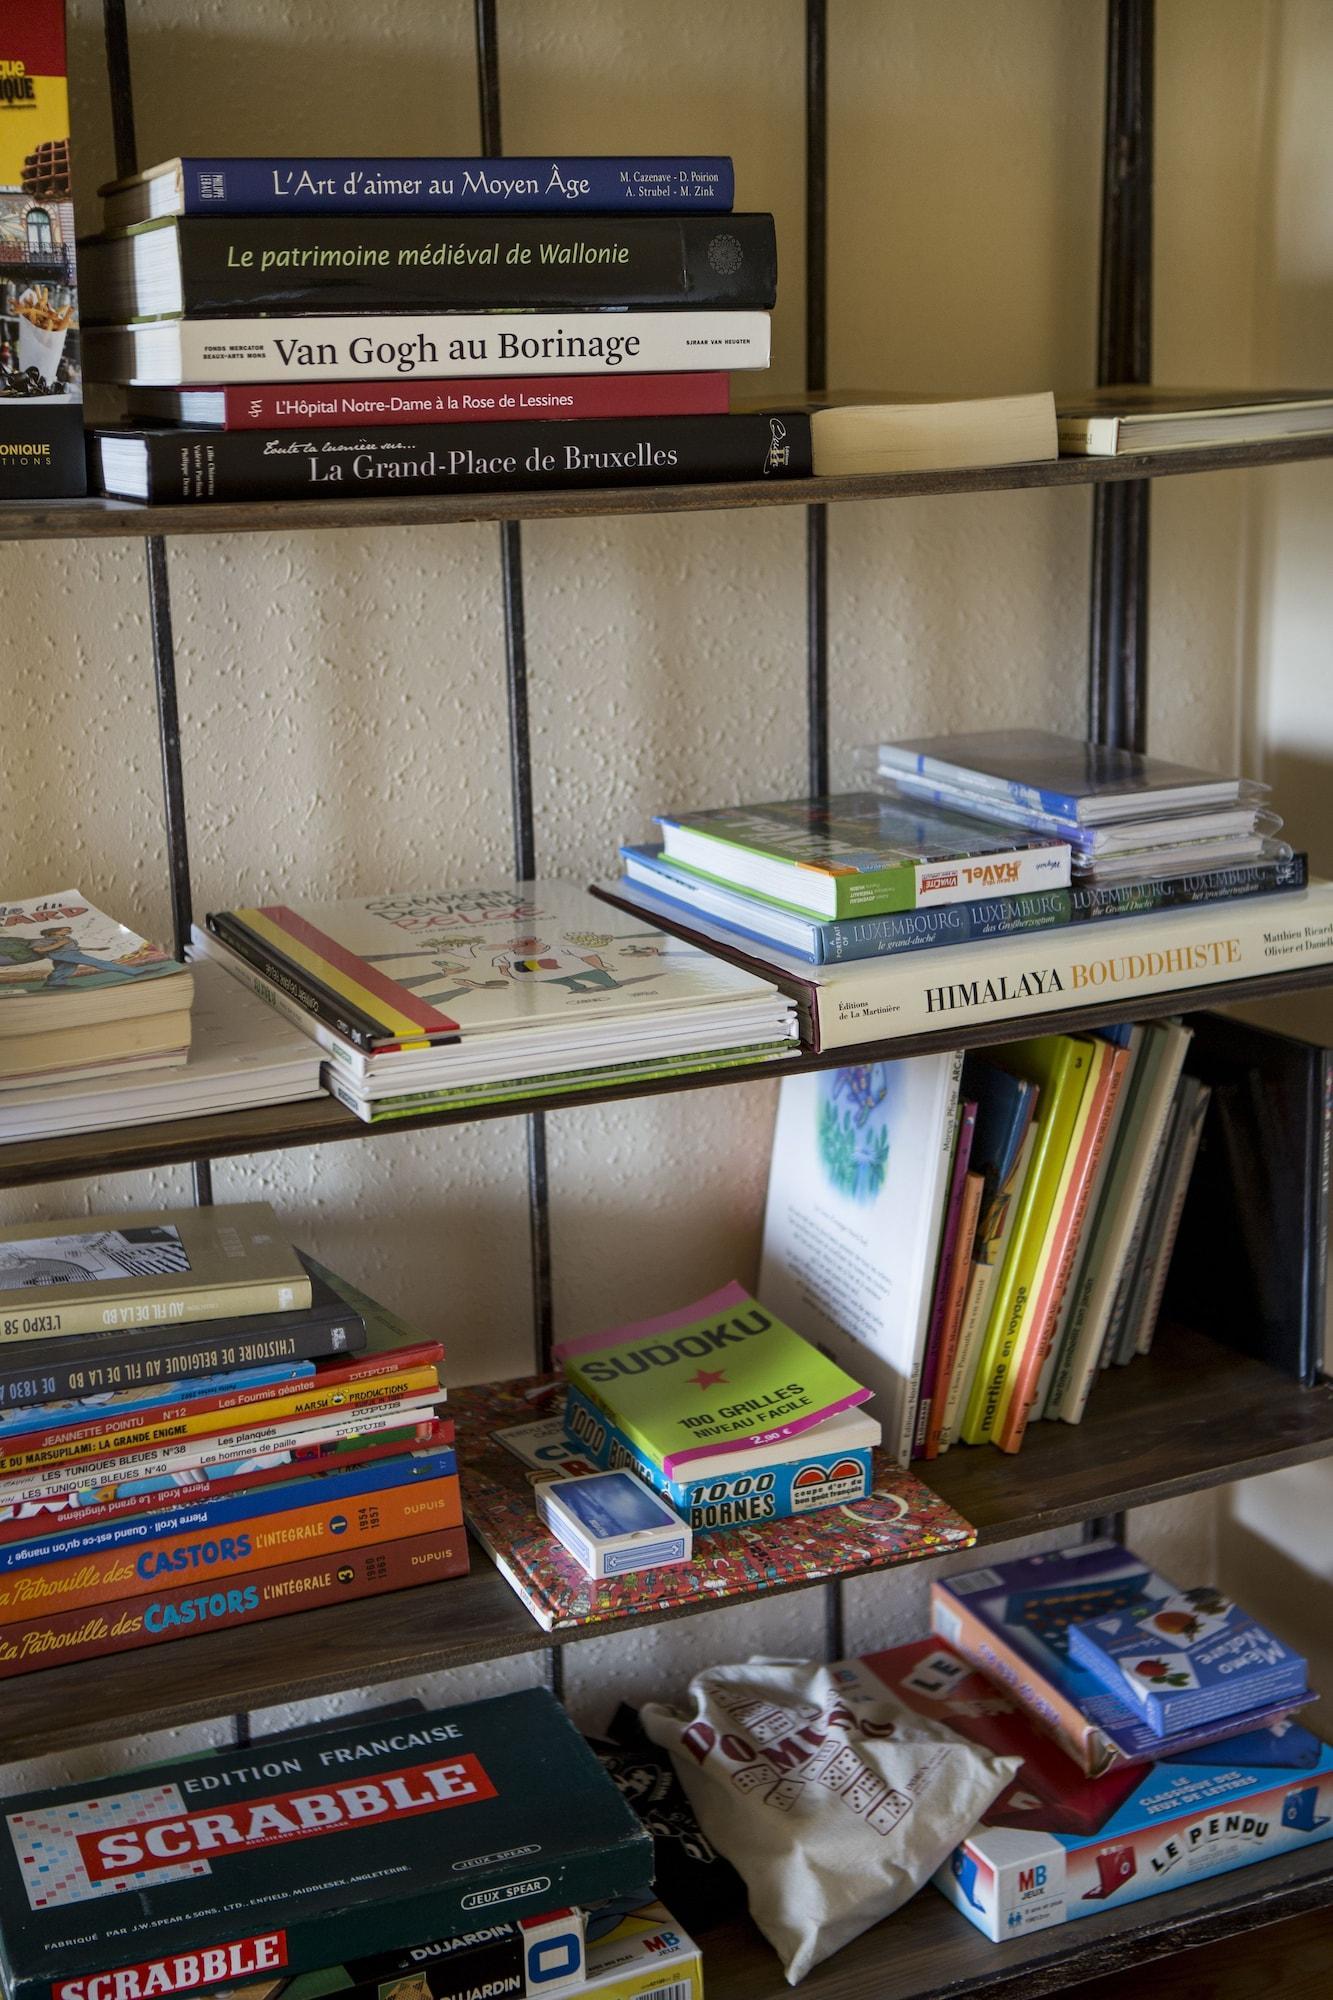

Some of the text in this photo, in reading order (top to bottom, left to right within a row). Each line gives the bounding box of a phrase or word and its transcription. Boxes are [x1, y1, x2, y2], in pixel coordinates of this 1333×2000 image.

[272, 164, 590, 199] L'Art d'aimer au Moyen Âge
[633, 171, 719, 183] Cazenave Poirion
[639, 186, 714, 197] Strubel Zink
[227, 243, 629, 272] Le patrimoine médiéval de Wallonie
[273, 329, 641, 372] Van Gogh au Borinage
[276, 400, 338, 417] L'Hôpital
[342, 397, 432, 413] Notre-Dame
[435, 396, 444, 409] à
[447, 396, 459, 409] la
[462, 395, 495, 409] Rose
[498, 394, 515, 407] de
[519, 394, 574, 407] Lessines
[308, 442, 678, 482] La Grand-Place de Bruxelles
[391, 906, 545, 931] BELGE
[887, 933, 936, 951] grand-duché
[1264, 944, 1293, 957] Olivier
[924, 939, 1242, 1013] HIMALAYA BOUDDHISTE
[862, 1004, 900, 1017] Martinière
[4, 1315, 61, 1335] L'EXPO 58
[103, 1302, 184, 1325] AU FIL DE LA BD
[580, 1310, 773, 1383] SUDOKU
[981, 1286, 1027, 1431] martine voyage
[9, 1339, 295, 1399] L'HISTOIRE DE BELGIQUE AU FIL DE LA BD DE 1830
[42, 1425, 103, 1447] JEANNETTE
[105, 1417, 144, 1433] POINTU
[162, 1408, 187, 1420] N°12
[218, 1398, 236, 1409] Les
[238, 1390, 276, 1405] Fourmis
[278, 1381, 315, 1398] géantes
[350, 1364, 399, 1381] DUPUIS
[677, 1383, 805, 1429] 100 GRILLES
[693, 1396, 814, 1439] NIVEAU FACILE
[9, 1383, 409, 1468] DU MARSUPILAMI: LA GRANDE ENIGME MARSU PRODUCTIONS
[42, 1471, 61, 1482] LES
[65, 1460, 116, 1478] TUNIQUES
[119, 1452, 158, 1466] BLEUES
[235, 1427, 277, 1444] planqués
[351, 1402, 401, 1417] DUPUIS
[570, 1402, 606, 1456] 1000
[22, 1420, 386, 1500] LES TUNIQUES BLEUES N°40 hommes paille DUPUIS
[58, 1482, 210, 1522] Pierre Kroll grand vingtième
[404, 1499, 445, 1515] DUPUIS
[690, 1472, 776, 1506] 1000
[794, 1481, 847, 1498] coupe d'or
[794, 1496, 810, 1505] bon
[811, 1491, 829, 1504] goût
[690, 1493, 776, 1530] BORNES
[15, 1512, 208, 1562] Pierre Kroll Quand est-ce qu'on mange
[12, 1534, 252, 1605] Patrouille des CASTORS
[412, 1549, 453, 1565] DUPUIS
[20, 1585, 260, 1658] Patrouille des CASTORS
[1217, 1640, 1287, 1675] Mémo
[184, 1724, 463, 1793] EDITION FRANCAISE
[98, 1763, 478, 1870] SCRABBLE
[460, 1846, 531, 1868] JEUX SPEAR
[1151, 1841, 1179, 1872] LE
[1189, 1815, 1269, 1845] PENDU
[469, 1881, 541, 1906] JEUX SPEAR
[1019, 1864, 1047, 1893] MB
[44, 1933, 98, 1950] FABRIQUÉ
[410, 1923, 514, 1961] DUJARDIN
[60, 1936, 280, 2000] SCRABBLE
